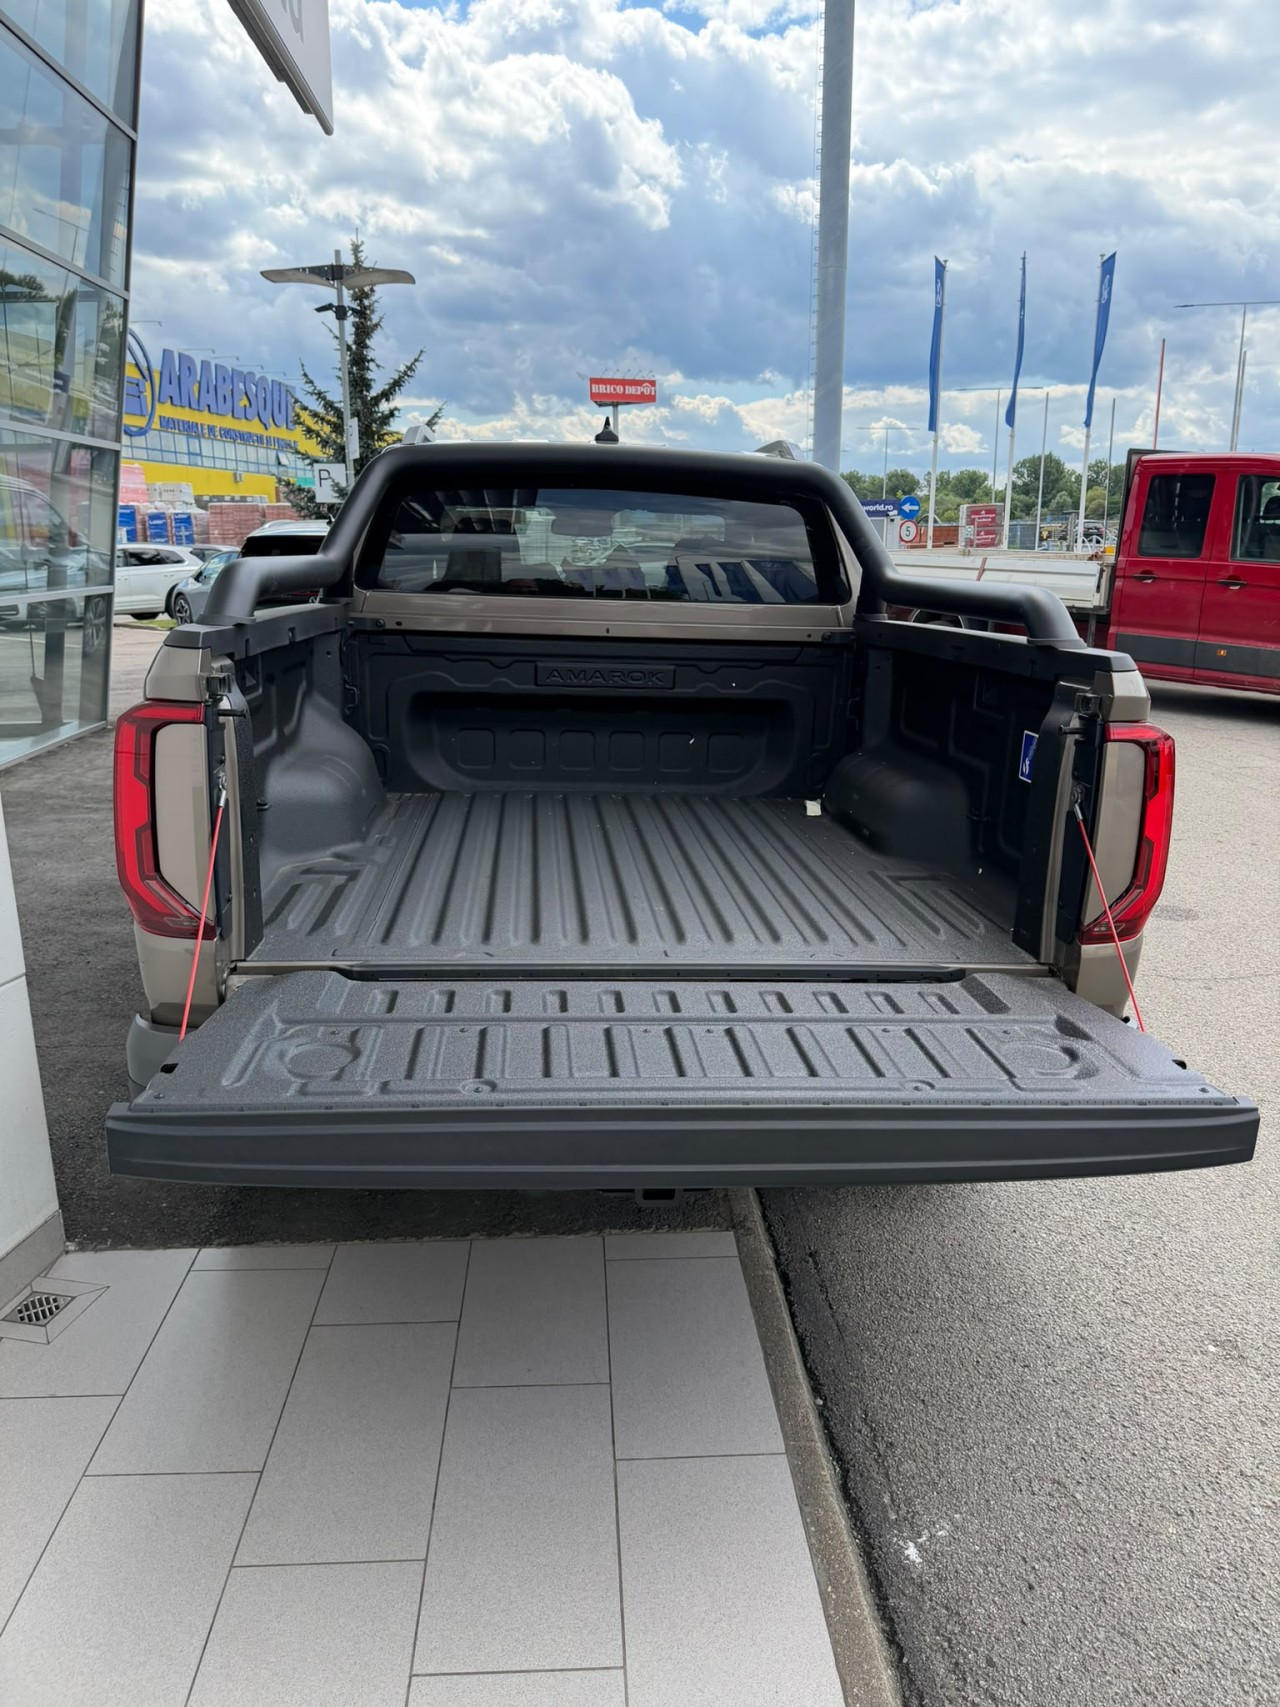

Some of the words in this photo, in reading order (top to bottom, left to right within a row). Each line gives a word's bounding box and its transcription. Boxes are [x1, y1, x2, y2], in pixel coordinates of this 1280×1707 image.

[158, 348, 296, 430] ARABESQUE
[591, 384, 624, 394] BRICO
[625, 382, 655, 395] DEPÔT
[159, 415, 207, 439] MATERIAE
[318, 469, 331, 487] P
[905, 526, 911, 537] 5
[546, 668, 664, 684] AMAROK
